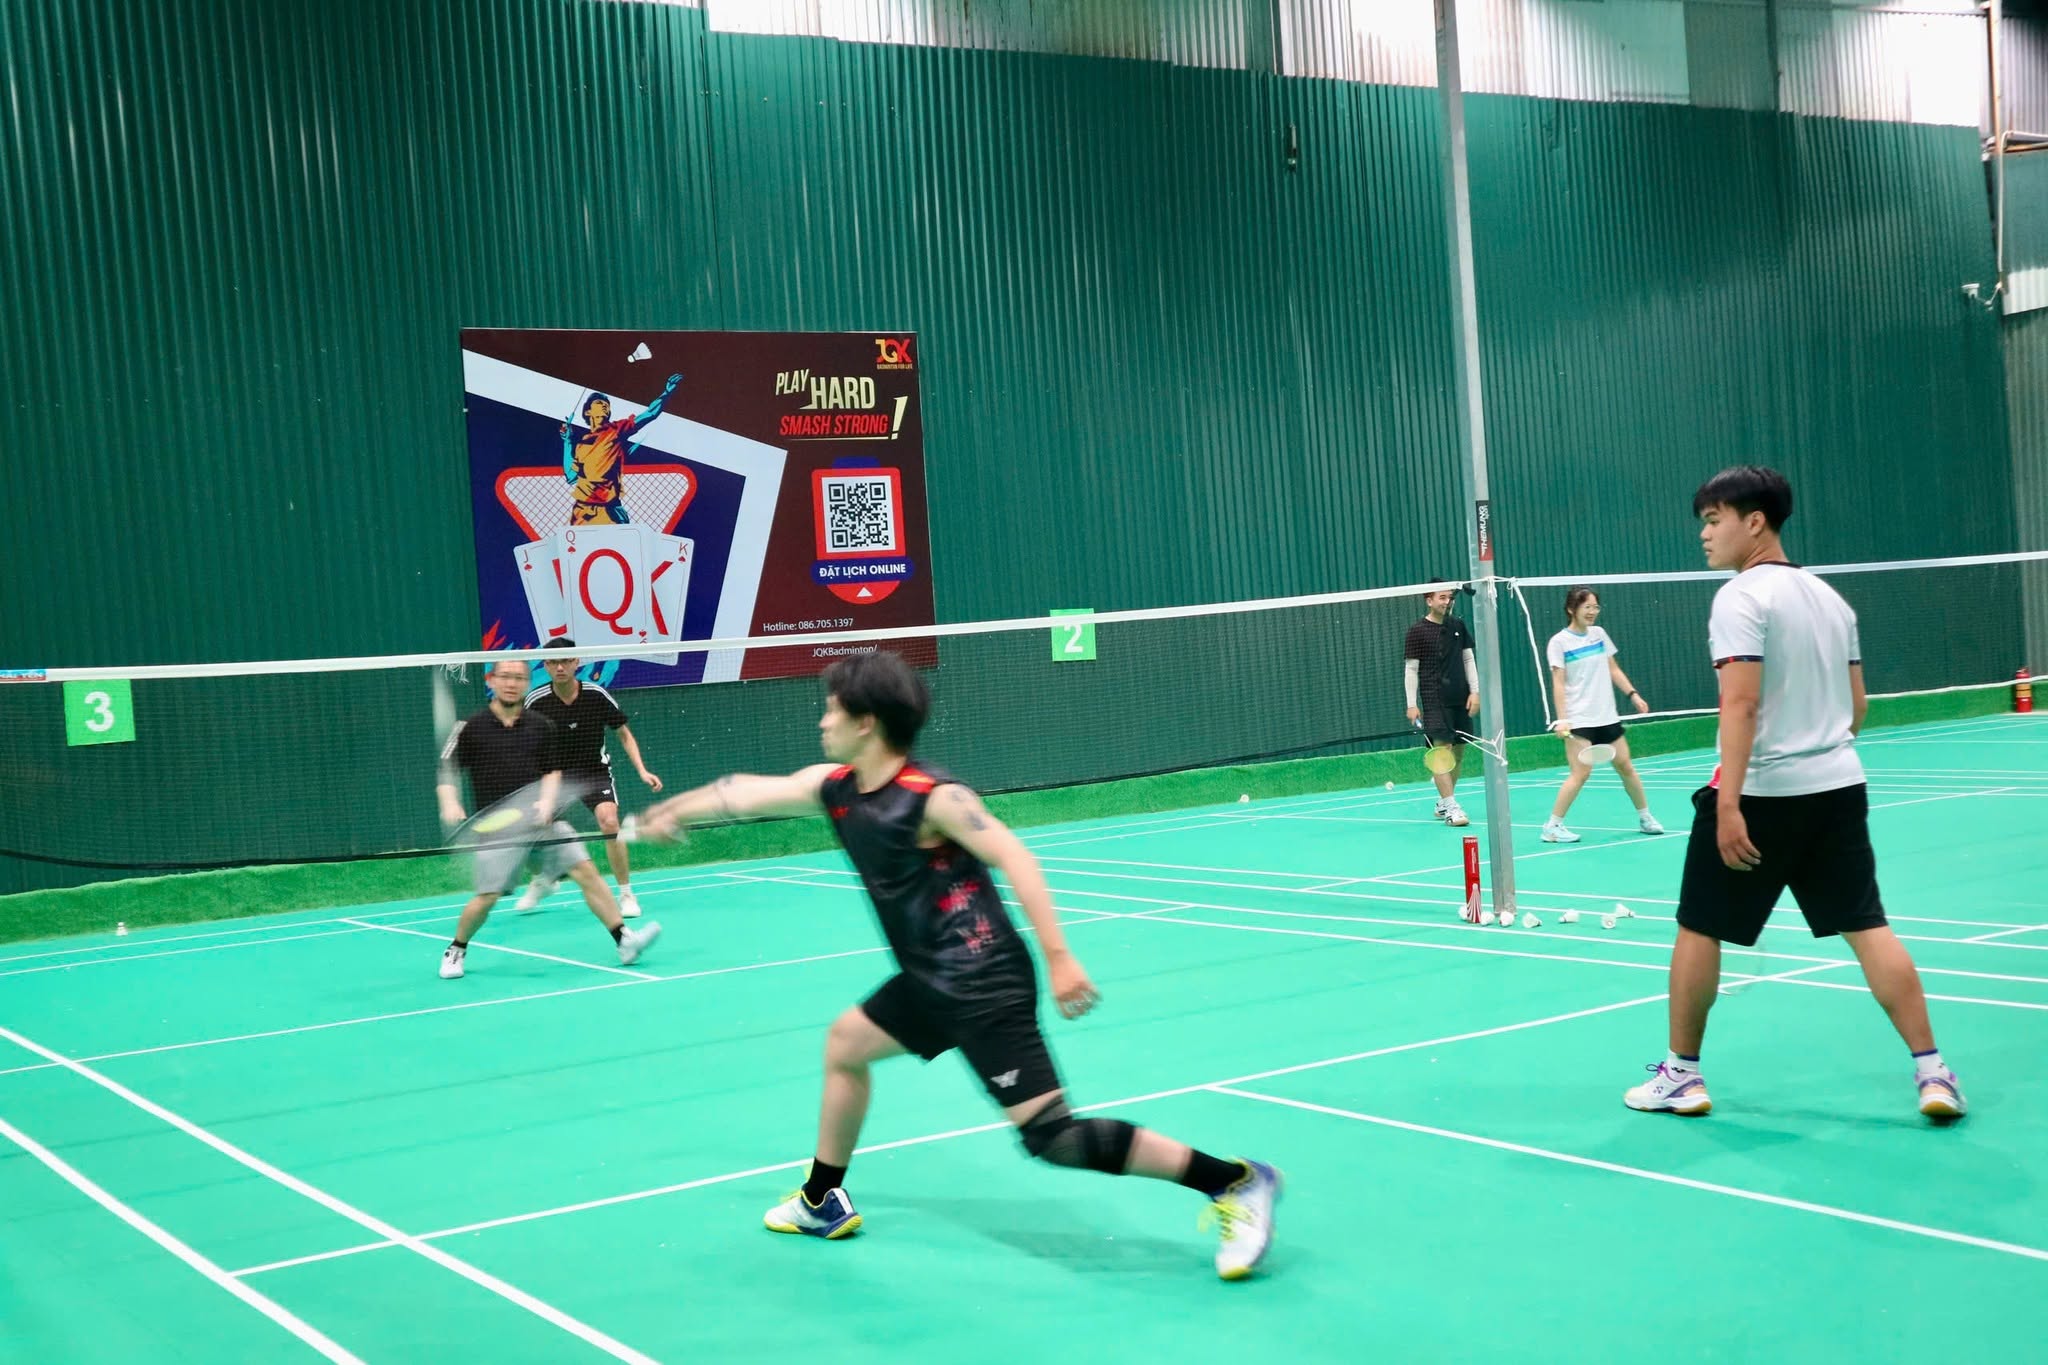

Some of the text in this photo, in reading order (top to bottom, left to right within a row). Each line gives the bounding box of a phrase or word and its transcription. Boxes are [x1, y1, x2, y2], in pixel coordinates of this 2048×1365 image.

[775, 368, 876, 410] PLAY HARD
[780, 415, 831, 436] SMASH
[833, 414, 889, 435] STRONG
[565, 529, 576, 545] Q
[522, 549, 530, 563] J
[678, 541, 689, 555] K
[819, 563, 907, 579] ĐẶT LỊCH ONLINE
[578, 548, 635, 636] Q
[763, 617, 854, 632] Hotline: 086.705.1397
[1064, 622, 1084, 653] 2
[84, 691, 114, 732] 3
